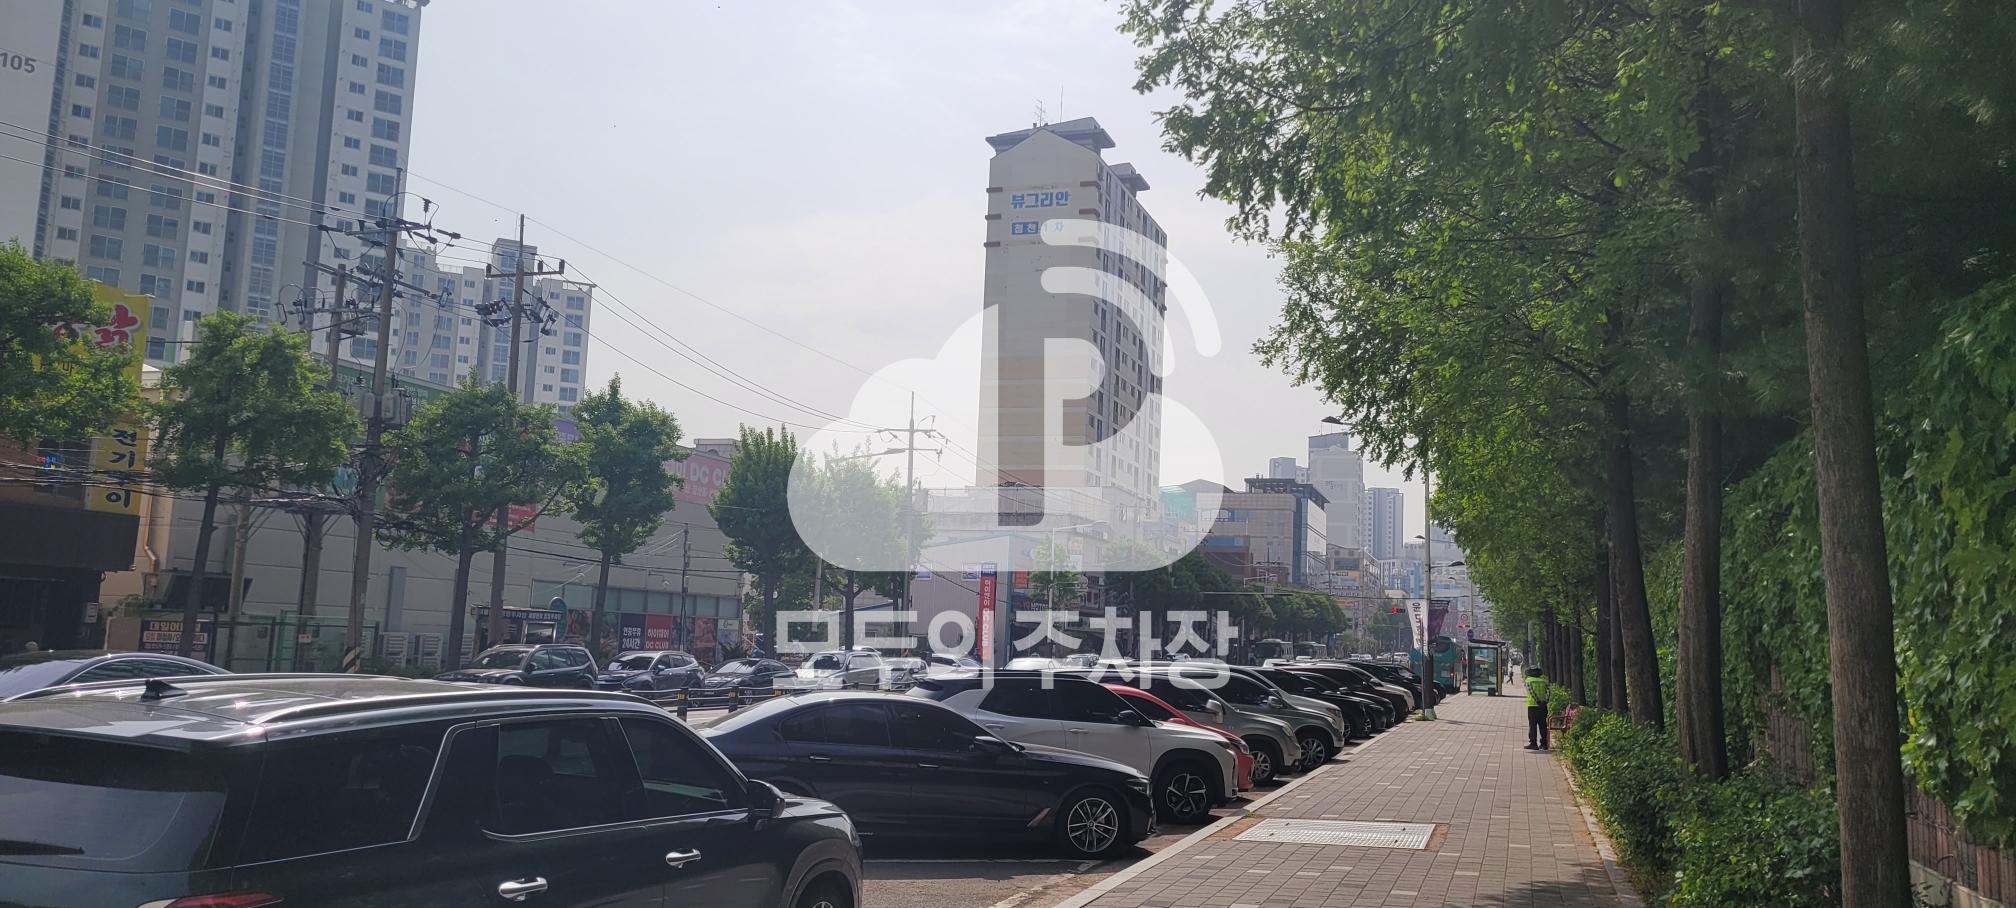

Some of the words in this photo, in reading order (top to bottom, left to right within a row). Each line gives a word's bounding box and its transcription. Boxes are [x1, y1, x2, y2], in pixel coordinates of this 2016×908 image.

[0, 52, 37, 73] 105
[1010, 191, 1071, 209] 뷰그리안
[690, 462, 710, 484] DC
[622, 638, 641, 649] 24시간
